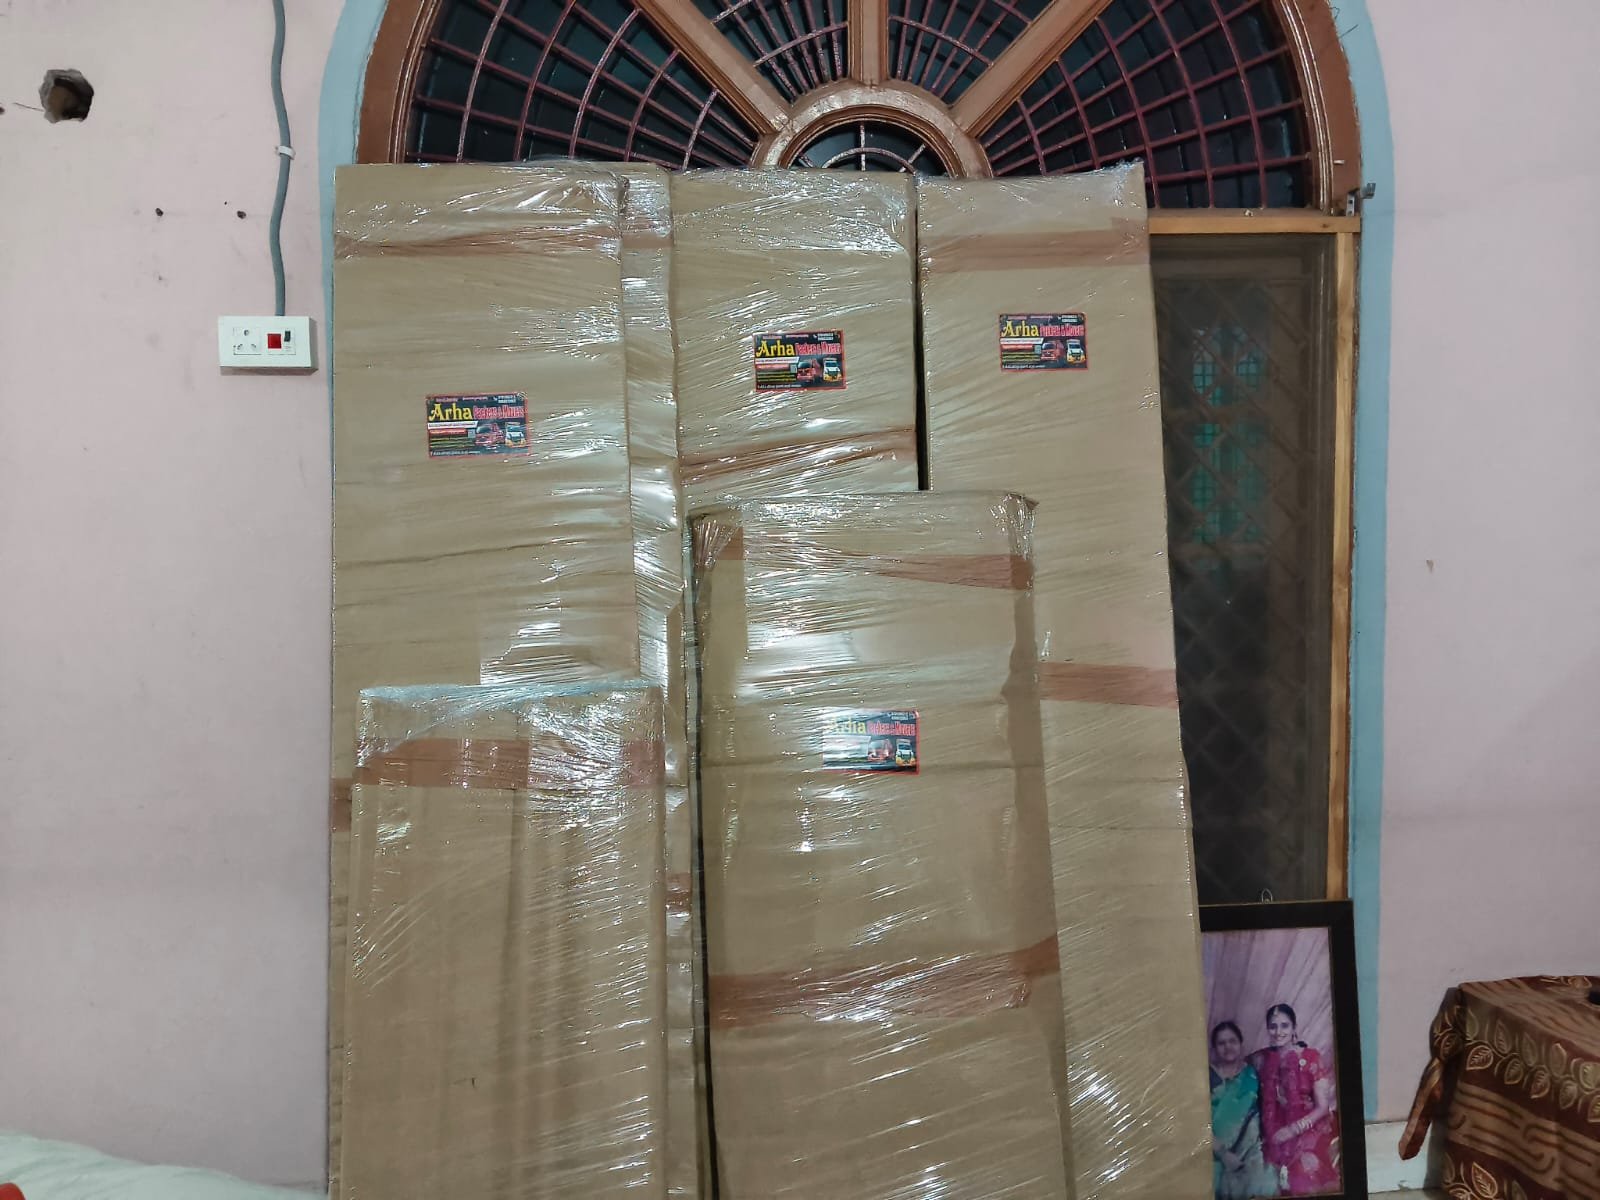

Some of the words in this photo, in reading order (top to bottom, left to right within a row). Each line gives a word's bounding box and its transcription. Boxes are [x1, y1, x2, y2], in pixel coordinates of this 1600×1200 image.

[1001, 320, 1039, 337] Arha
[756, 339, 795, 357] Arha
[429, 402, 474, 421] Arha
